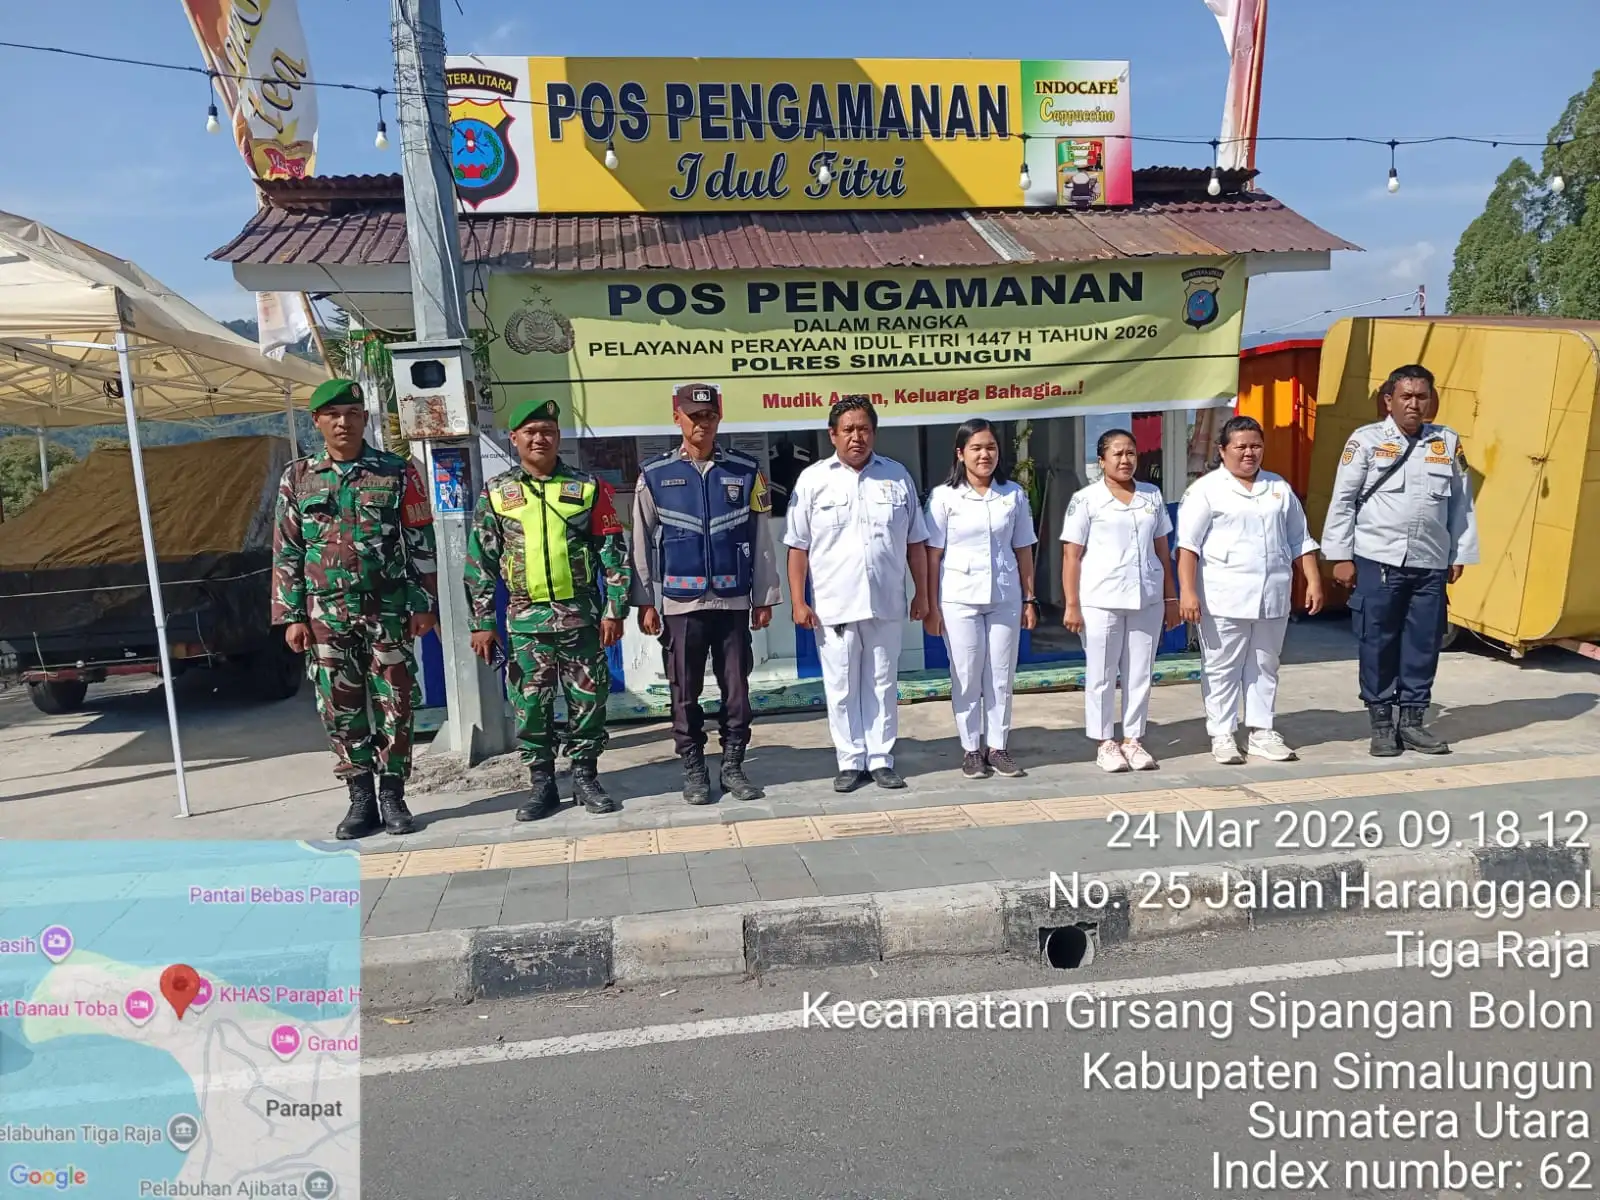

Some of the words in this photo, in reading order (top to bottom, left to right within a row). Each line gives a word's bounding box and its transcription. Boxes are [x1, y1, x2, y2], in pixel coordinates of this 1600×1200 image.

[445, 73, 475, 86] TERA
[478, 74, 512, 92] UTARA
[546, 82, 650, 142] POS
[665, 82, 1009, 142] PENGAMANAN
[1040, 97, 1115, 126] Cappuccino
[669, 152, 790, 200] Idul
[804, 151, 907, 199] Fitri
[607, 282, 726, 316] POS
[747, 271, 1143, 314] PENGAMANAN
[794, 317, 870, 333] DALAM
[877, 314, 968, 330] RANGKA
[589, 339, 724, 357] PELAYANAN
[731, 337, 848, 354] PERAYAAN
[854, 334, 902, 351] IDUL
[909, 333, 960, 349] FITRI
[966, 331, 1011, 347] 1447
[1018, 330, 1032, 345] H
[1038, 327, 1108, 344] TAHUN
[1115, 324, 1158, 340] 2026
[732, 355, 841, 372] POLRES
[850, 348, 1032, 369] SIMALUNGUN
[762, 391, 823, 409] Mudik
[828, 391, 888, 408] An,
[894, 388, 979, 405] Keluarga
[985, 380, 1084, 399] Bahagia...!
